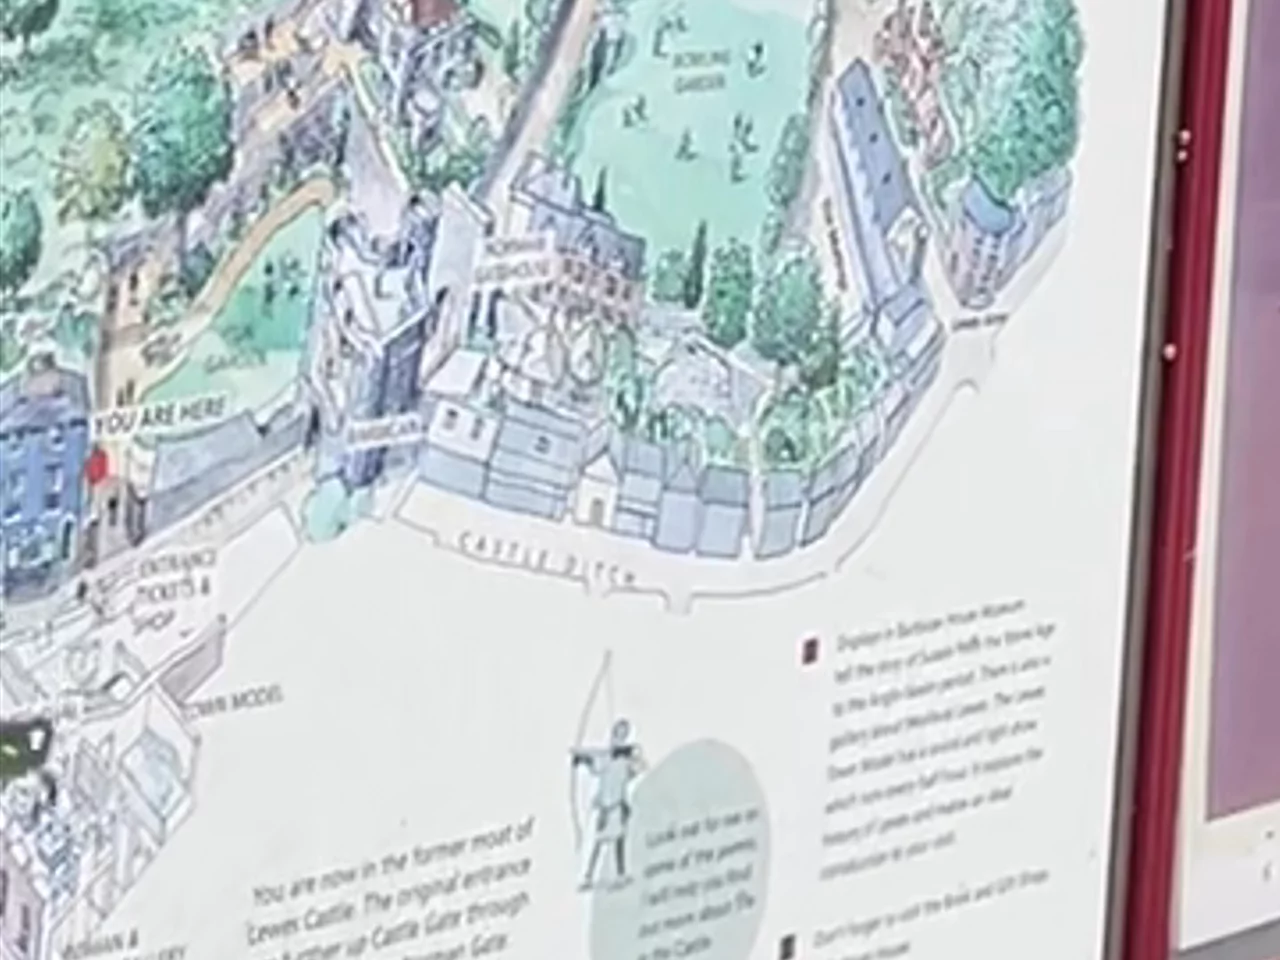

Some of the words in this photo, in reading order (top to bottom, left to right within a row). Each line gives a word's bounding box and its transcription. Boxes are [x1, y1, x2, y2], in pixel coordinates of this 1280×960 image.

[95, 410, 138, 435] YOU
[141, 404, 175, 427] ARE
[179, 394, 227, 421] HERE
[245, 918, 299, 947] Lewes
[363, 890, 393, 916] The
[462, 857, 533, 890] entrance
[253, 883, 285, 907] You
[289, 875, 316, 898] are
[319, 867, 357, 891] now
[380, 852, 409, 876] the
[411, 837, 468, 867] former
